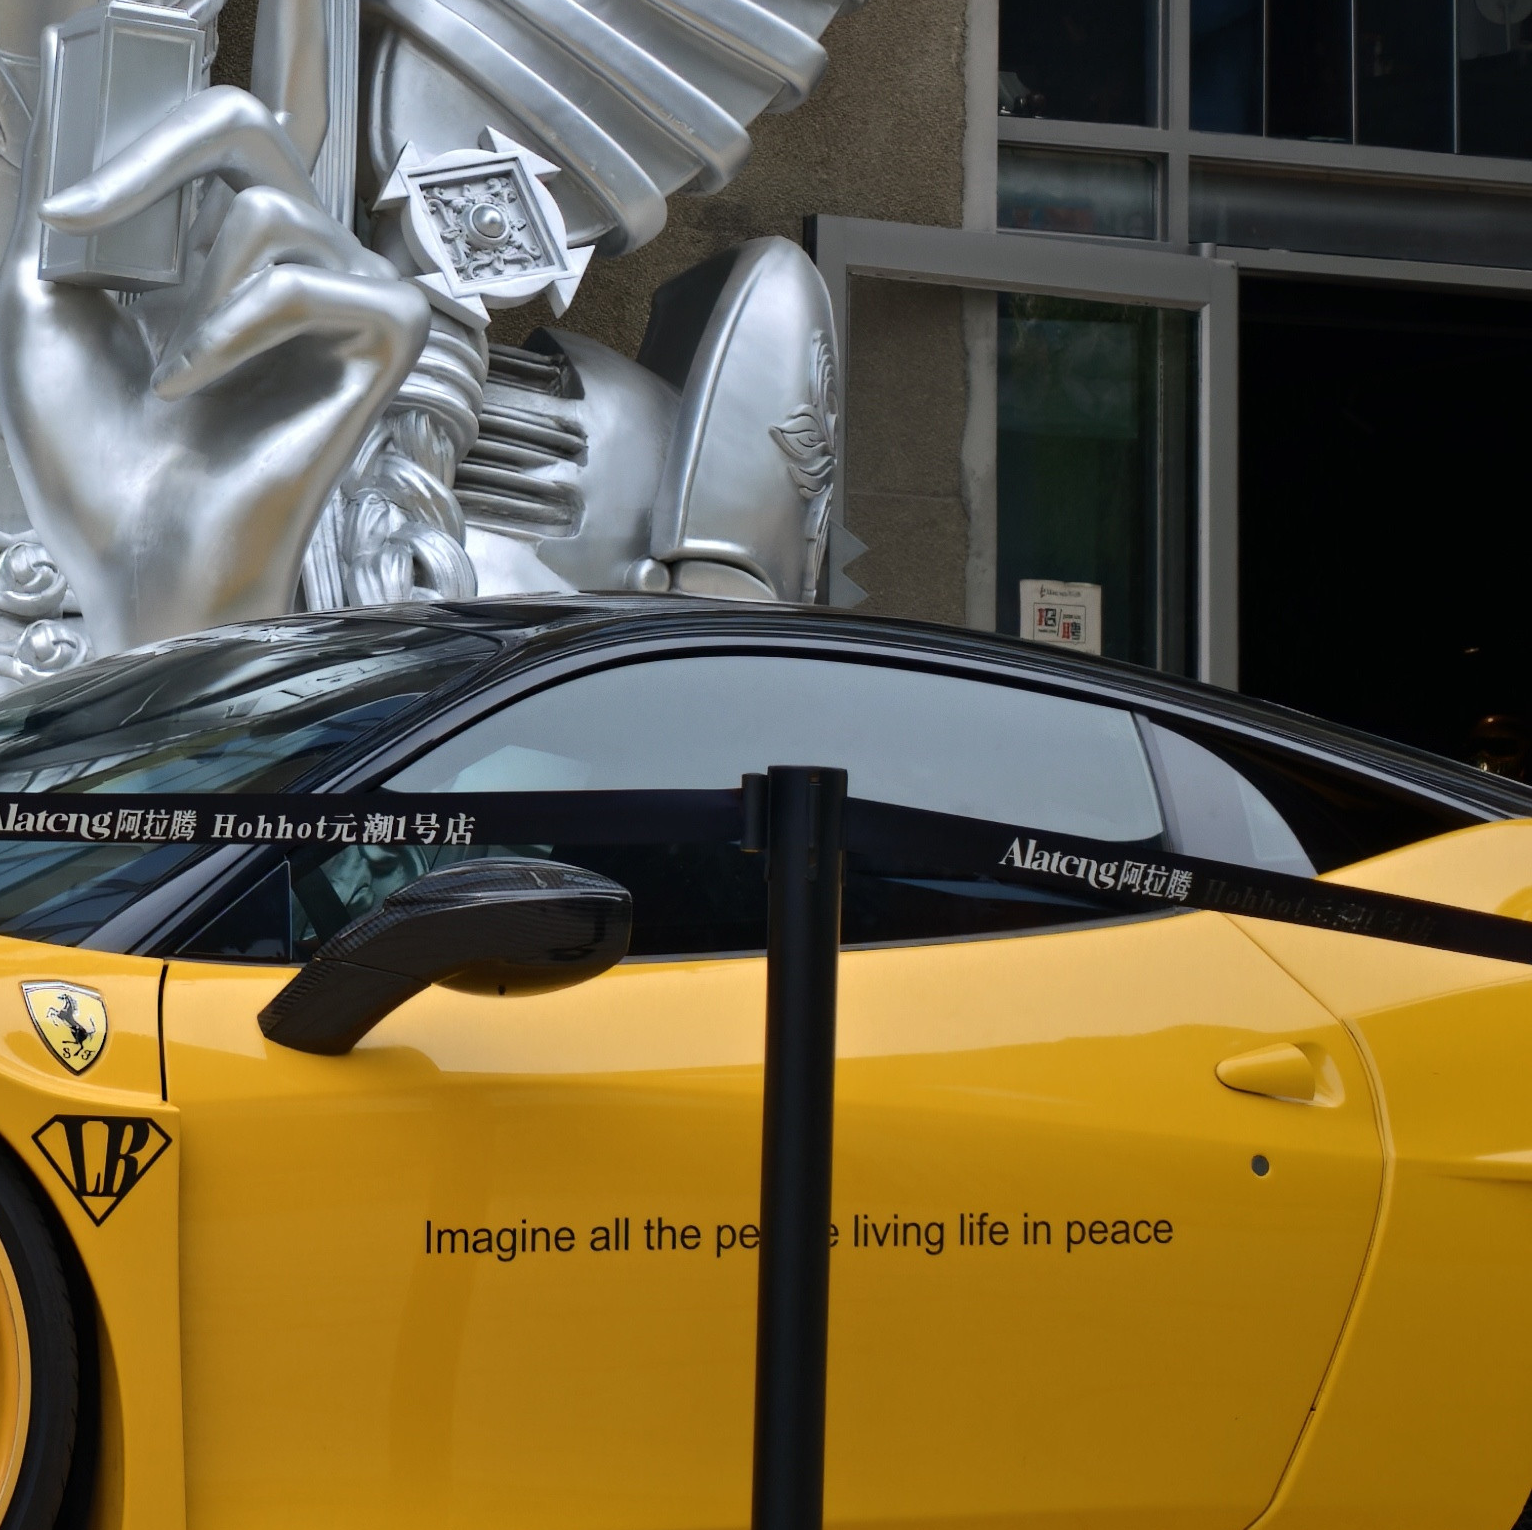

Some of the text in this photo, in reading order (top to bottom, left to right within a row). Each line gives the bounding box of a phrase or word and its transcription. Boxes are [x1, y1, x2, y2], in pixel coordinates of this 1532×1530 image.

[424, 1219, 576, 1262] Imagine
[589, 1217, 631, 1252] all
[643, 1216, 703, 1251] the
[853, 1213, 945, 1256] living
[959, 1212, 1010, 1246] life
[1023, 1212, 1052, 1245] in
[1066, 1219, 1174, 1254] peace
